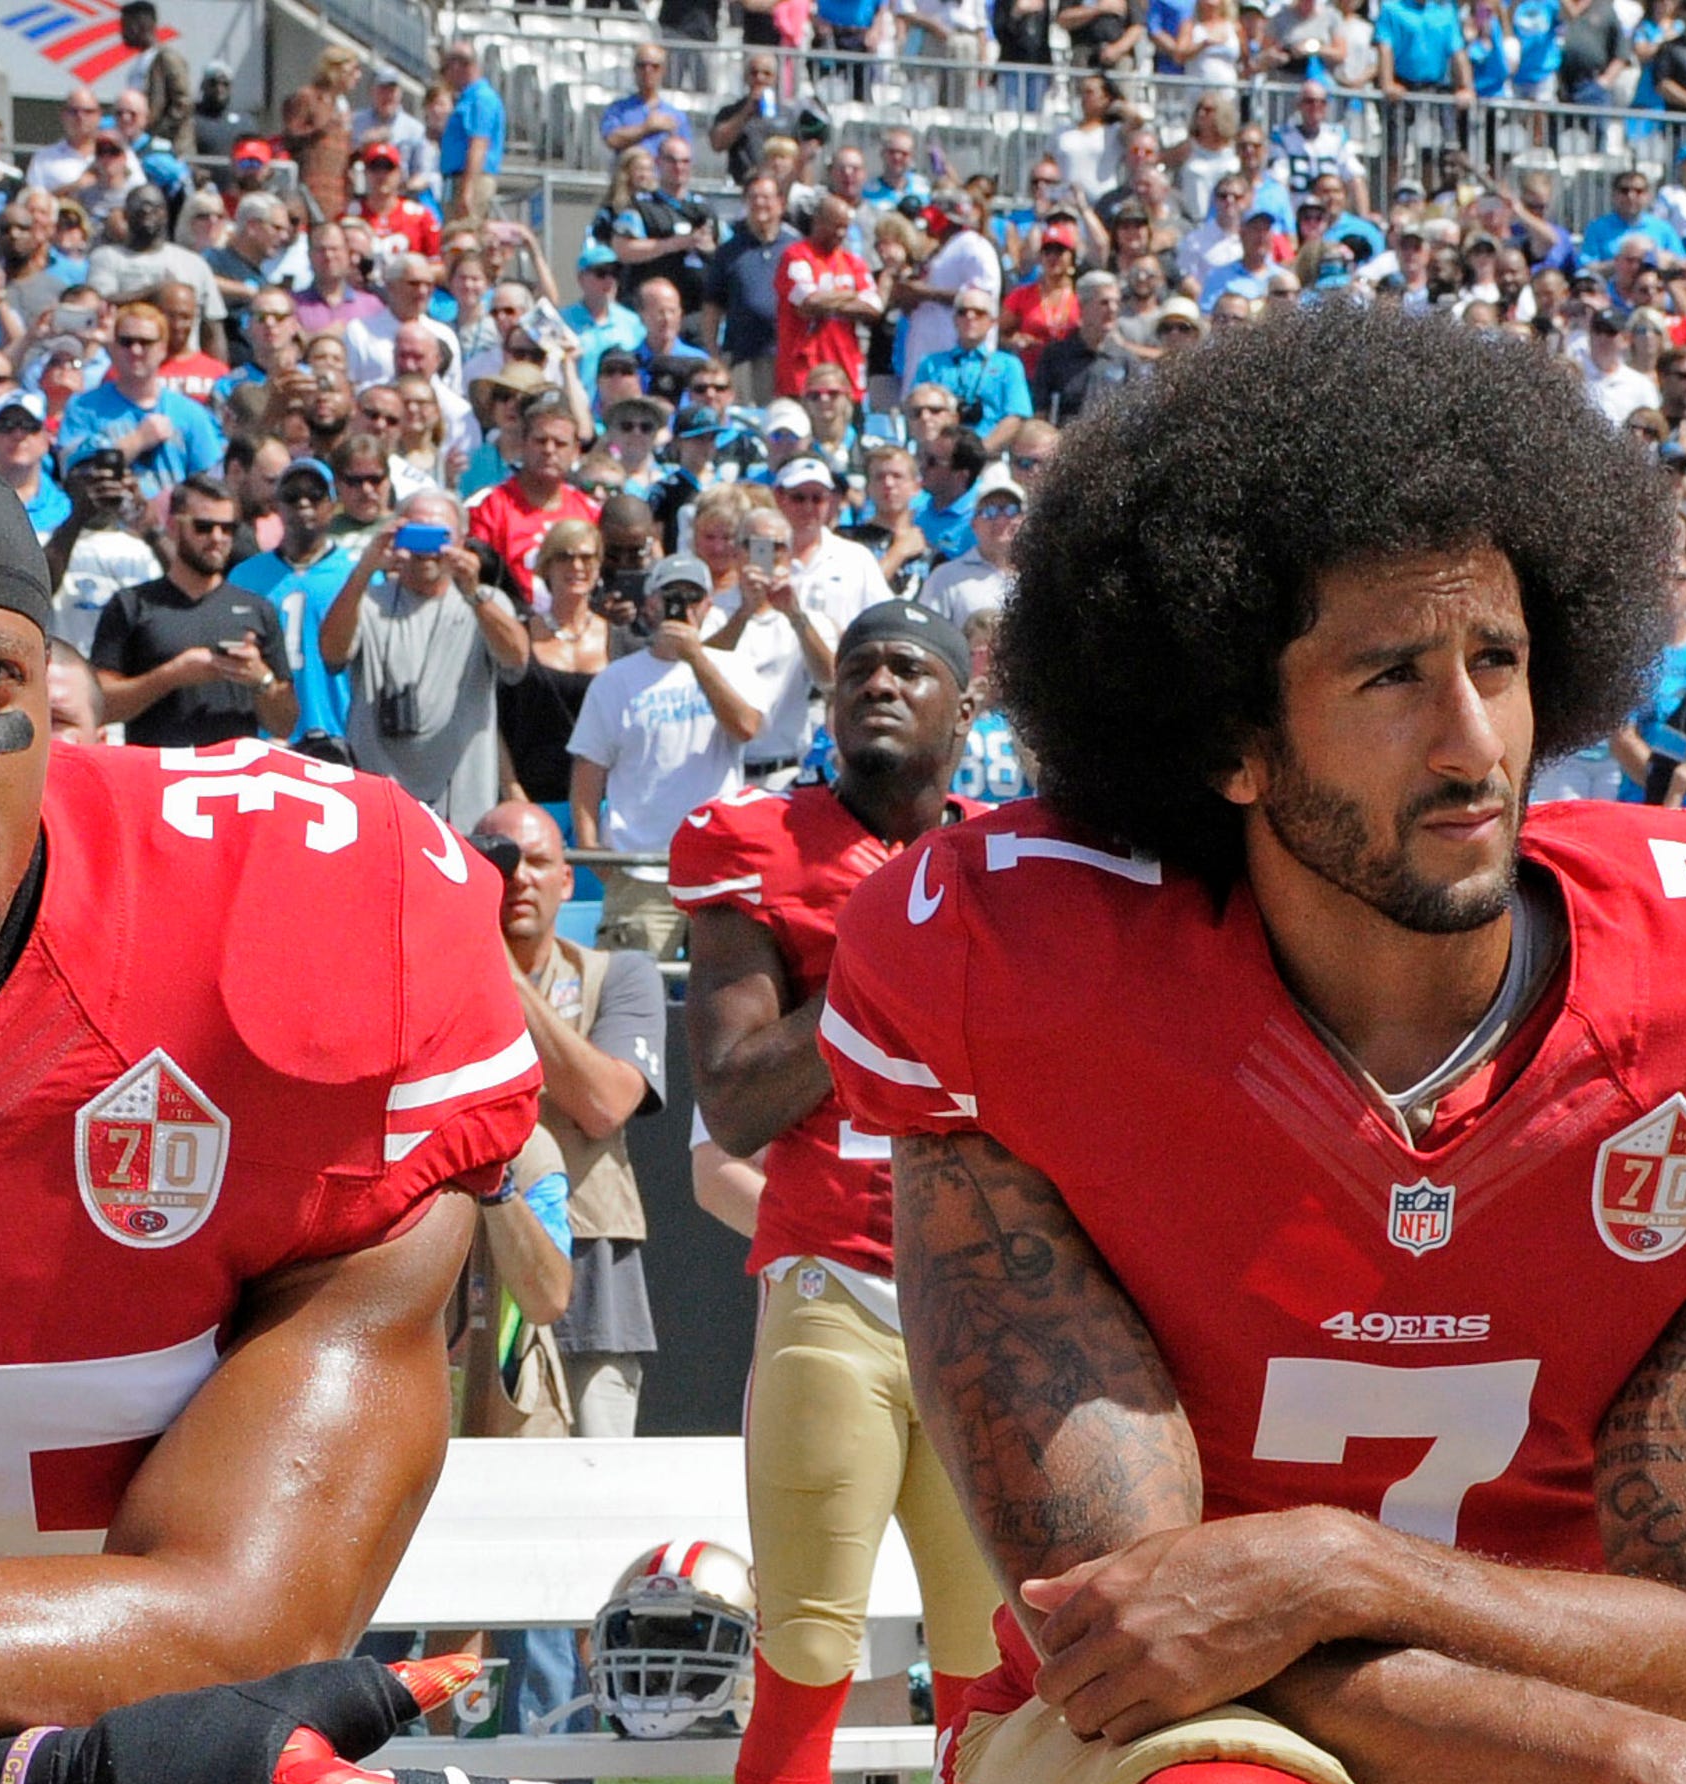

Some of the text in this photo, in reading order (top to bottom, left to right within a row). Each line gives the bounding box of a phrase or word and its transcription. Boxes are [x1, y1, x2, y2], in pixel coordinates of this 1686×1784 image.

[109, 1128, 196, 1186] 70
[115, 1190, 187, 1204] YEARS
[1398, 1212, 1441, 1242] NFL
[1320, 1311, 1491, 1345] 49ERS
[1252, 1357, 1542, 1547] 7
